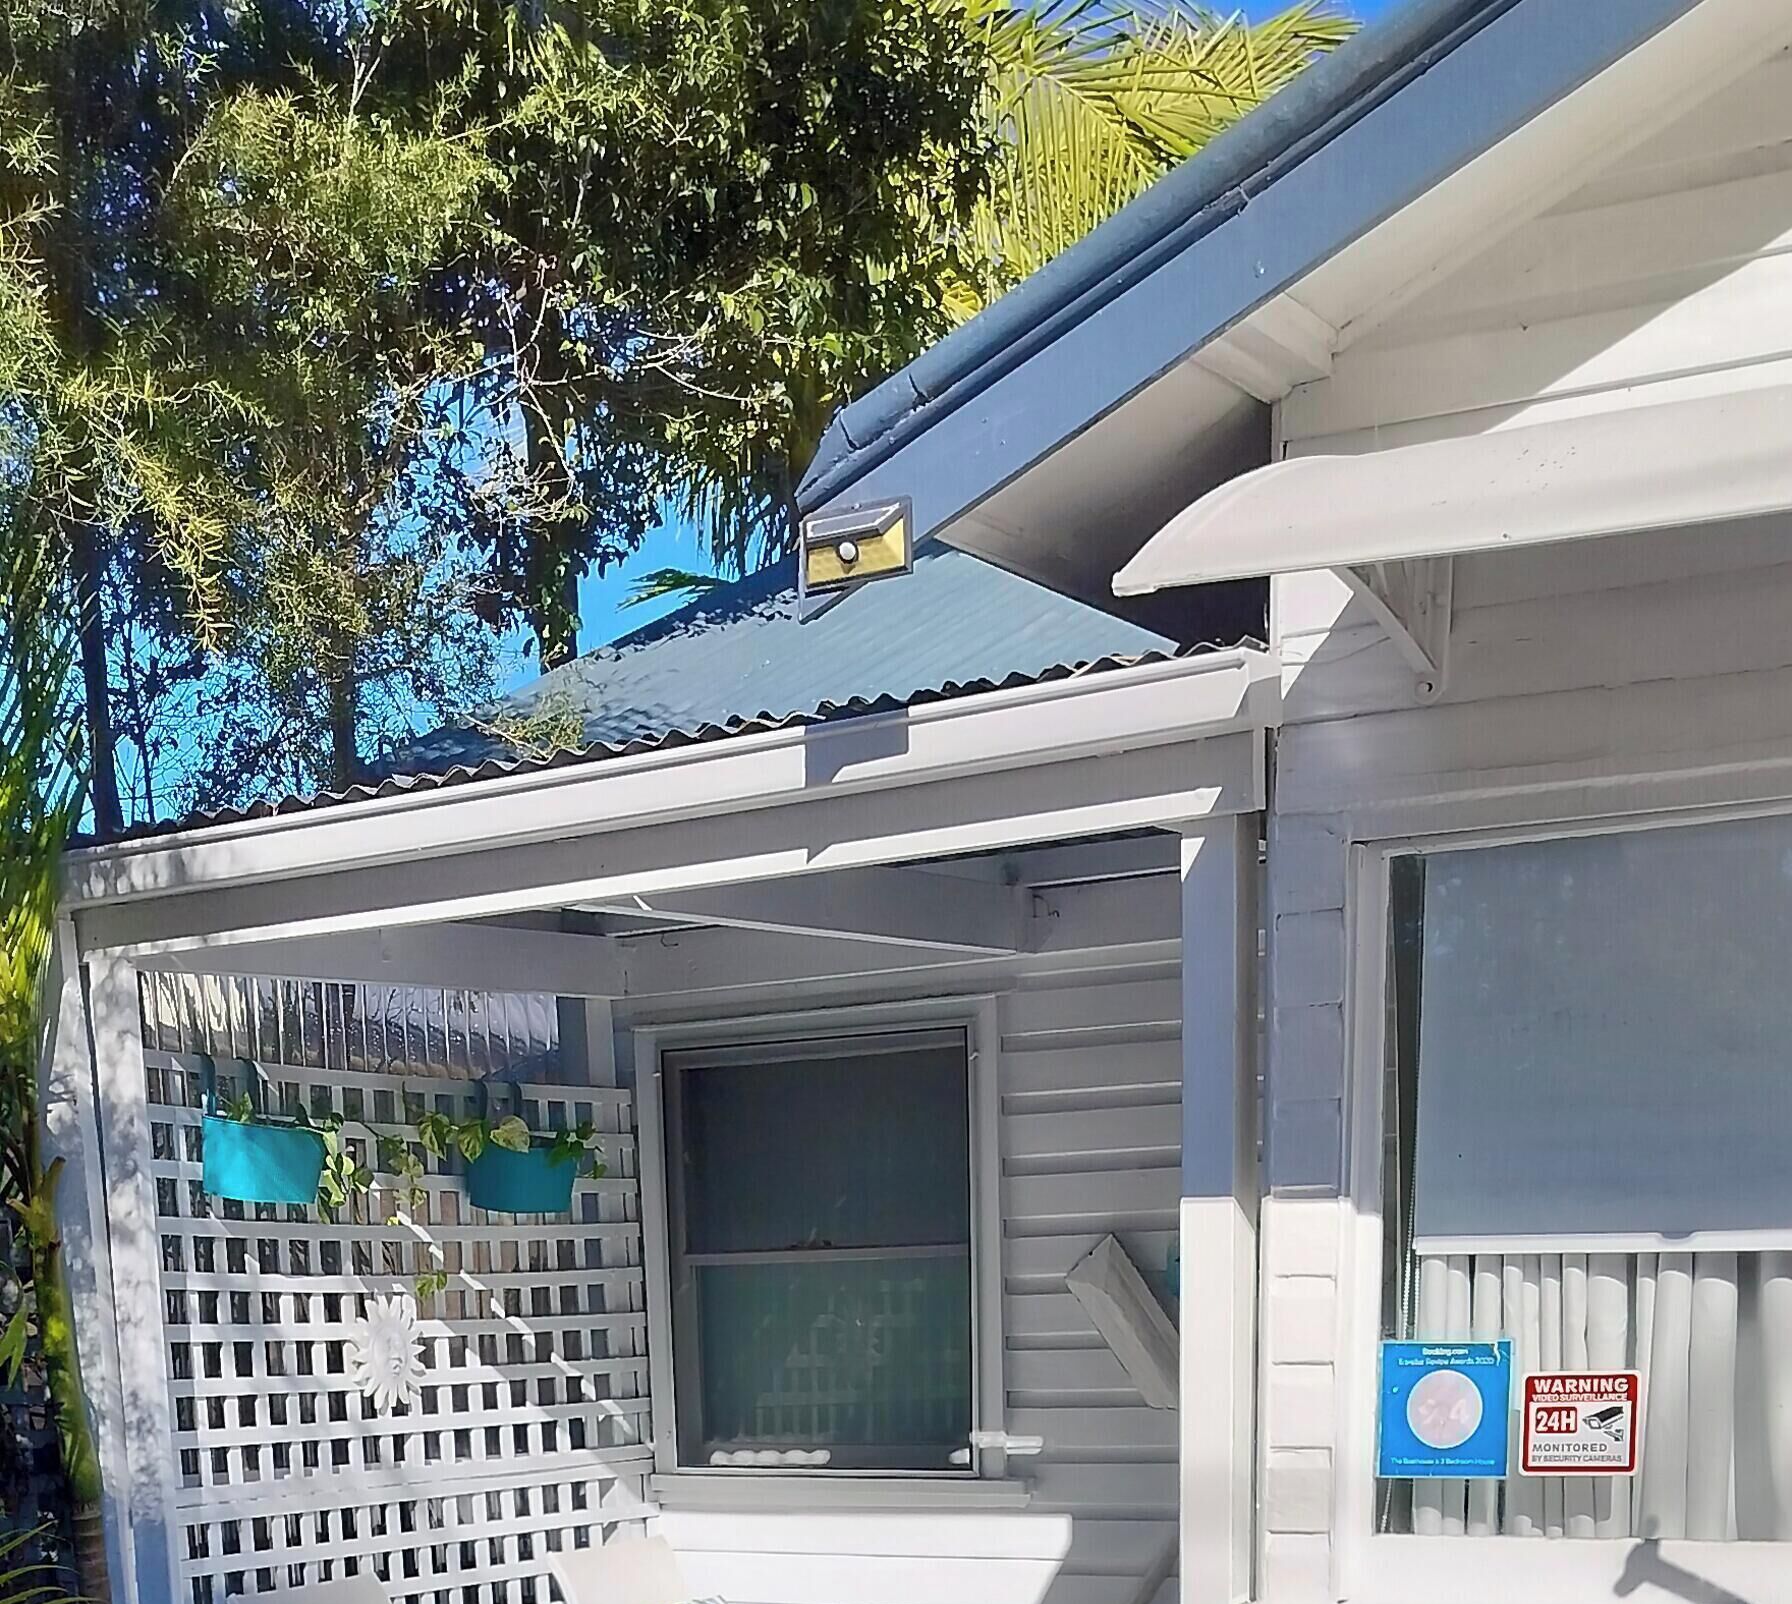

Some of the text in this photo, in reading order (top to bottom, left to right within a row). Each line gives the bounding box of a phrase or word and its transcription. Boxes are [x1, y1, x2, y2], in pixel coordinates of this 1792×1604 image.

[1534, 1378, 1628, 1393] WARNING
[1532, 1393, 1628, 1402] VIDEO SURVEILLANCE
[1536, 1410, 1577, 1432] 24H
[1532, 1443, 1608, 1453] MONITORED
[1544, 1454, 1582, 1462] SECURITY
[1583, 1454, 1622, 1462] CAMERAS
